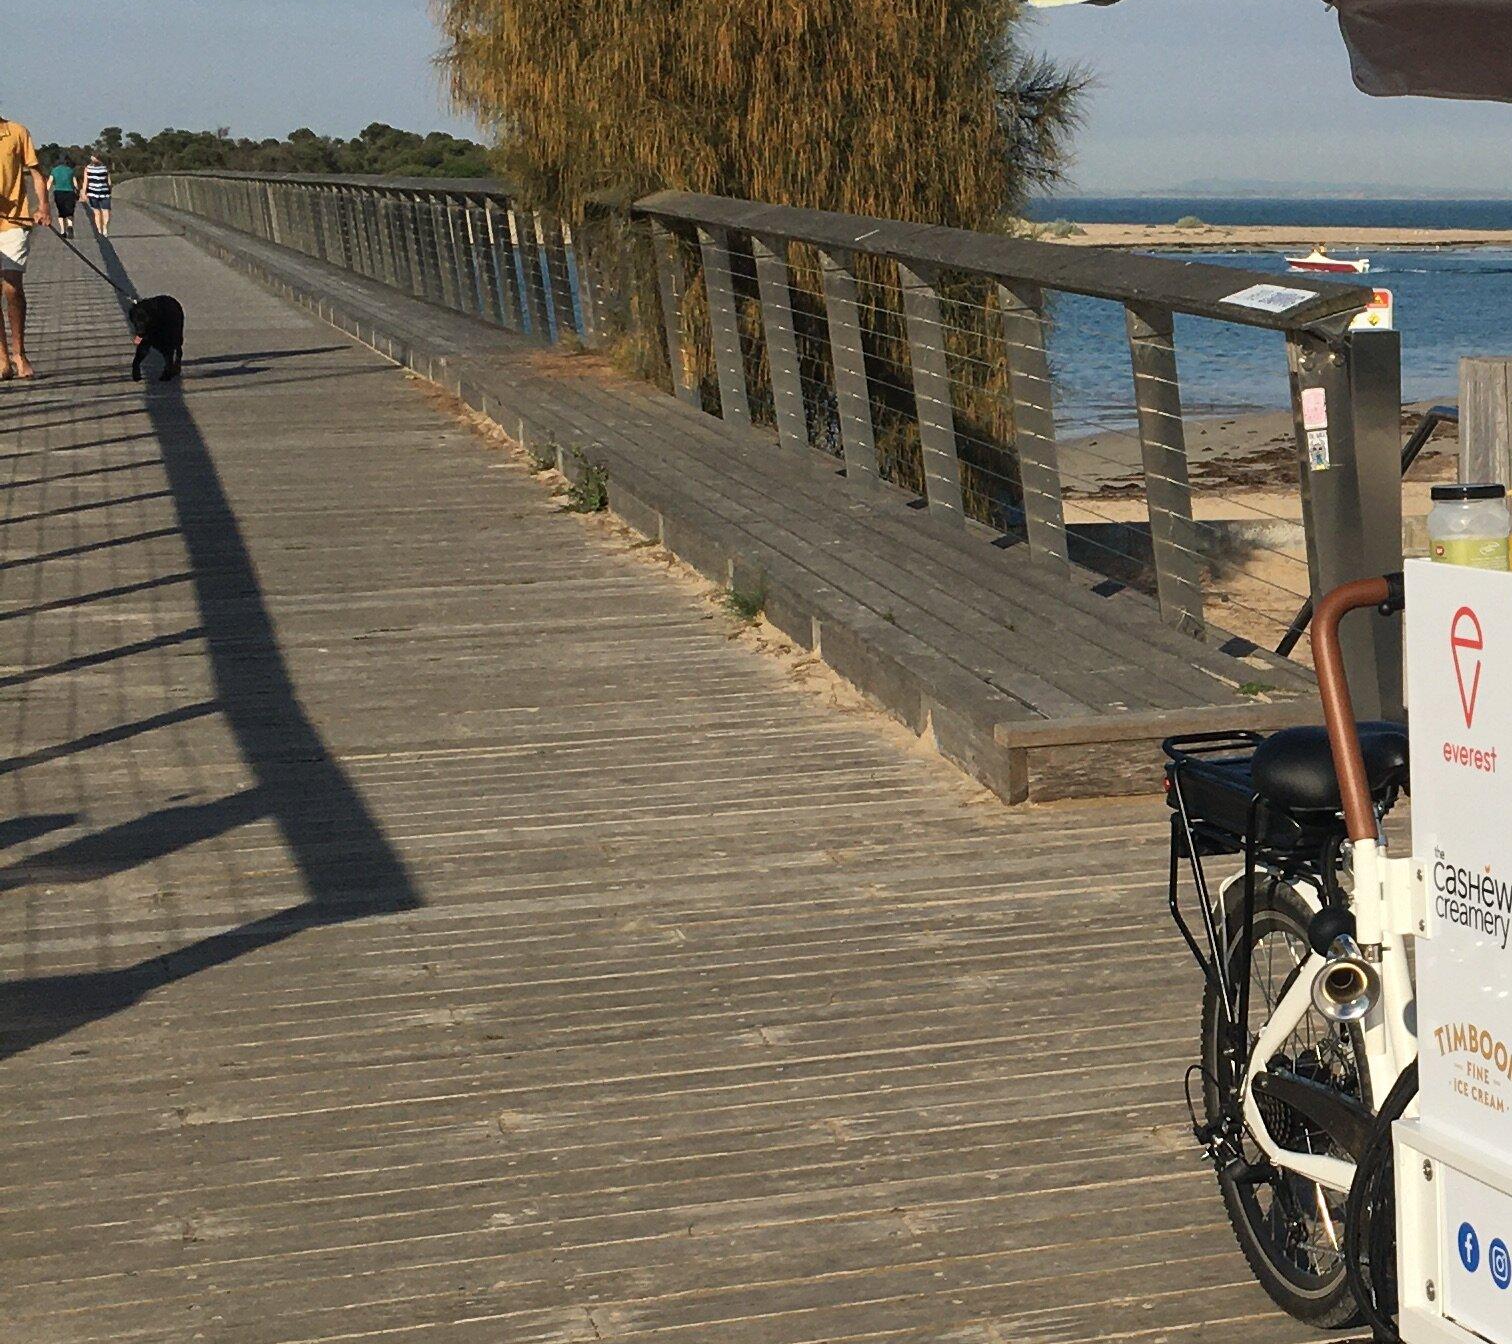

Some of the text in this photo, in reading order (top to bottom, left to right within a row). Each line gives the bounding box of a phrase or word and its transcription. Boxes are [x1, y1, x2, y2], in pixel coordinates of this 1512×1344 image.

[1443, 741, 1497, 773] everest
[1434, 845, 1445, 860] the
[1435, 894, 1510, 950] creamery
[1467, 1060, 1490, 1085] FINE
[1453, 1077, 1505, 1113] ICE CREAM
